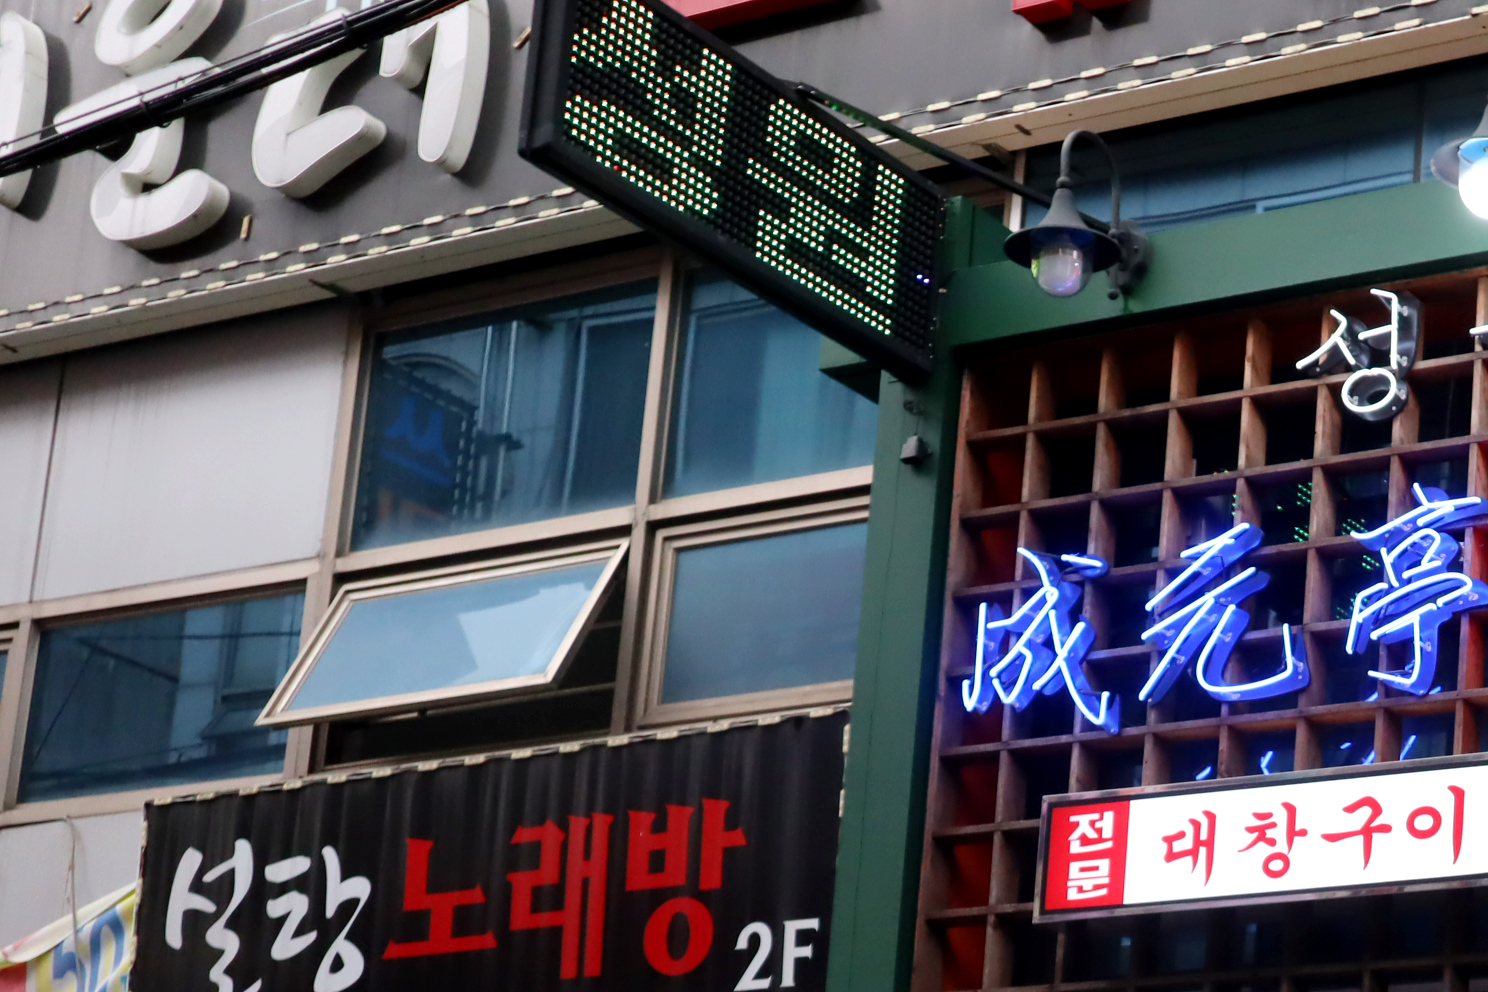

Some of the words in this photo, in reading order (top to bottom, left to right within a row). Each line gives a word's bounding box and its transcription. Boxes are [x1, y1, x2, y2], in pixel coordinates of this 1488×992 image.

[382, 797, 747, 979] 노래방
[734, 917, 820, 992] 2F
[1066, 810, 1115, 901] 전문
